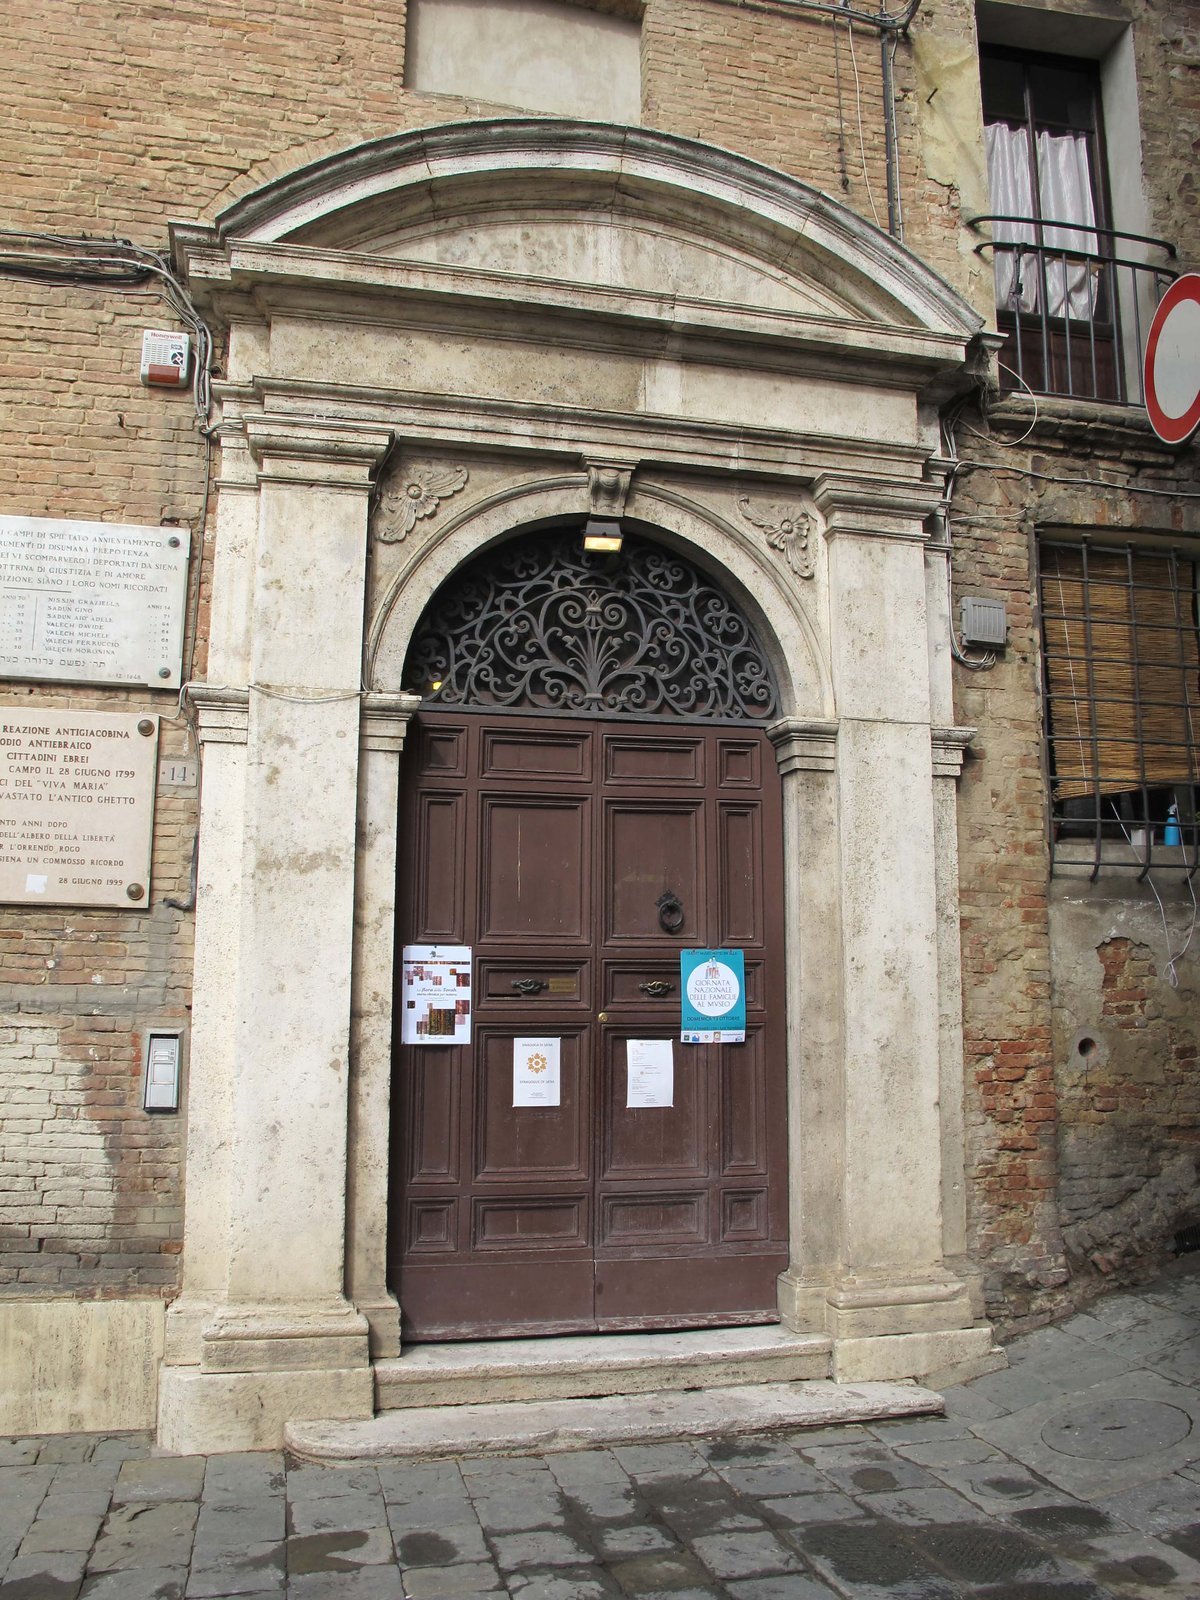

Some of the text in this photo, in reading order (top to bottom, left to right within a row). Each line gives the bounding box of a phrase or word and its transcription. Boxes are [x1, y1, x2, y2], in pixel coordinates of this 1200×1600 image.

[151, 332, 182, 340] Honeywell
[49, 544, 88, 552] DISUMANA
[93, 547, 148, 557] PREPOTENZA
[25, 554, 85, 564] SCOMPARVERO
[93, 558, 138, 568] DEPORTATI
[49, 567, 91, 576] GIUSTIZIA
[124, 583, 168, 592] RICORDATI
[78, 599, 120, 607] GRAZIELLA
[76, 640, 120, 648] FERRUCCIO
[3, 725, 130, 738] REAZIONE ANTIGIACOBINA
[28, 740, 92, 750] ANTIEBRAICO
[7, 752, 89, 763] CITTADINI EBREI
[9, 766, 41, 774] CAMPO
[74, 768, 110, 777] GIUGNO
[170, 766, 187, 781] 14
[49, 794, 93, 803] L'ANTICO
[98, 796, 135, 804] GHETTO
